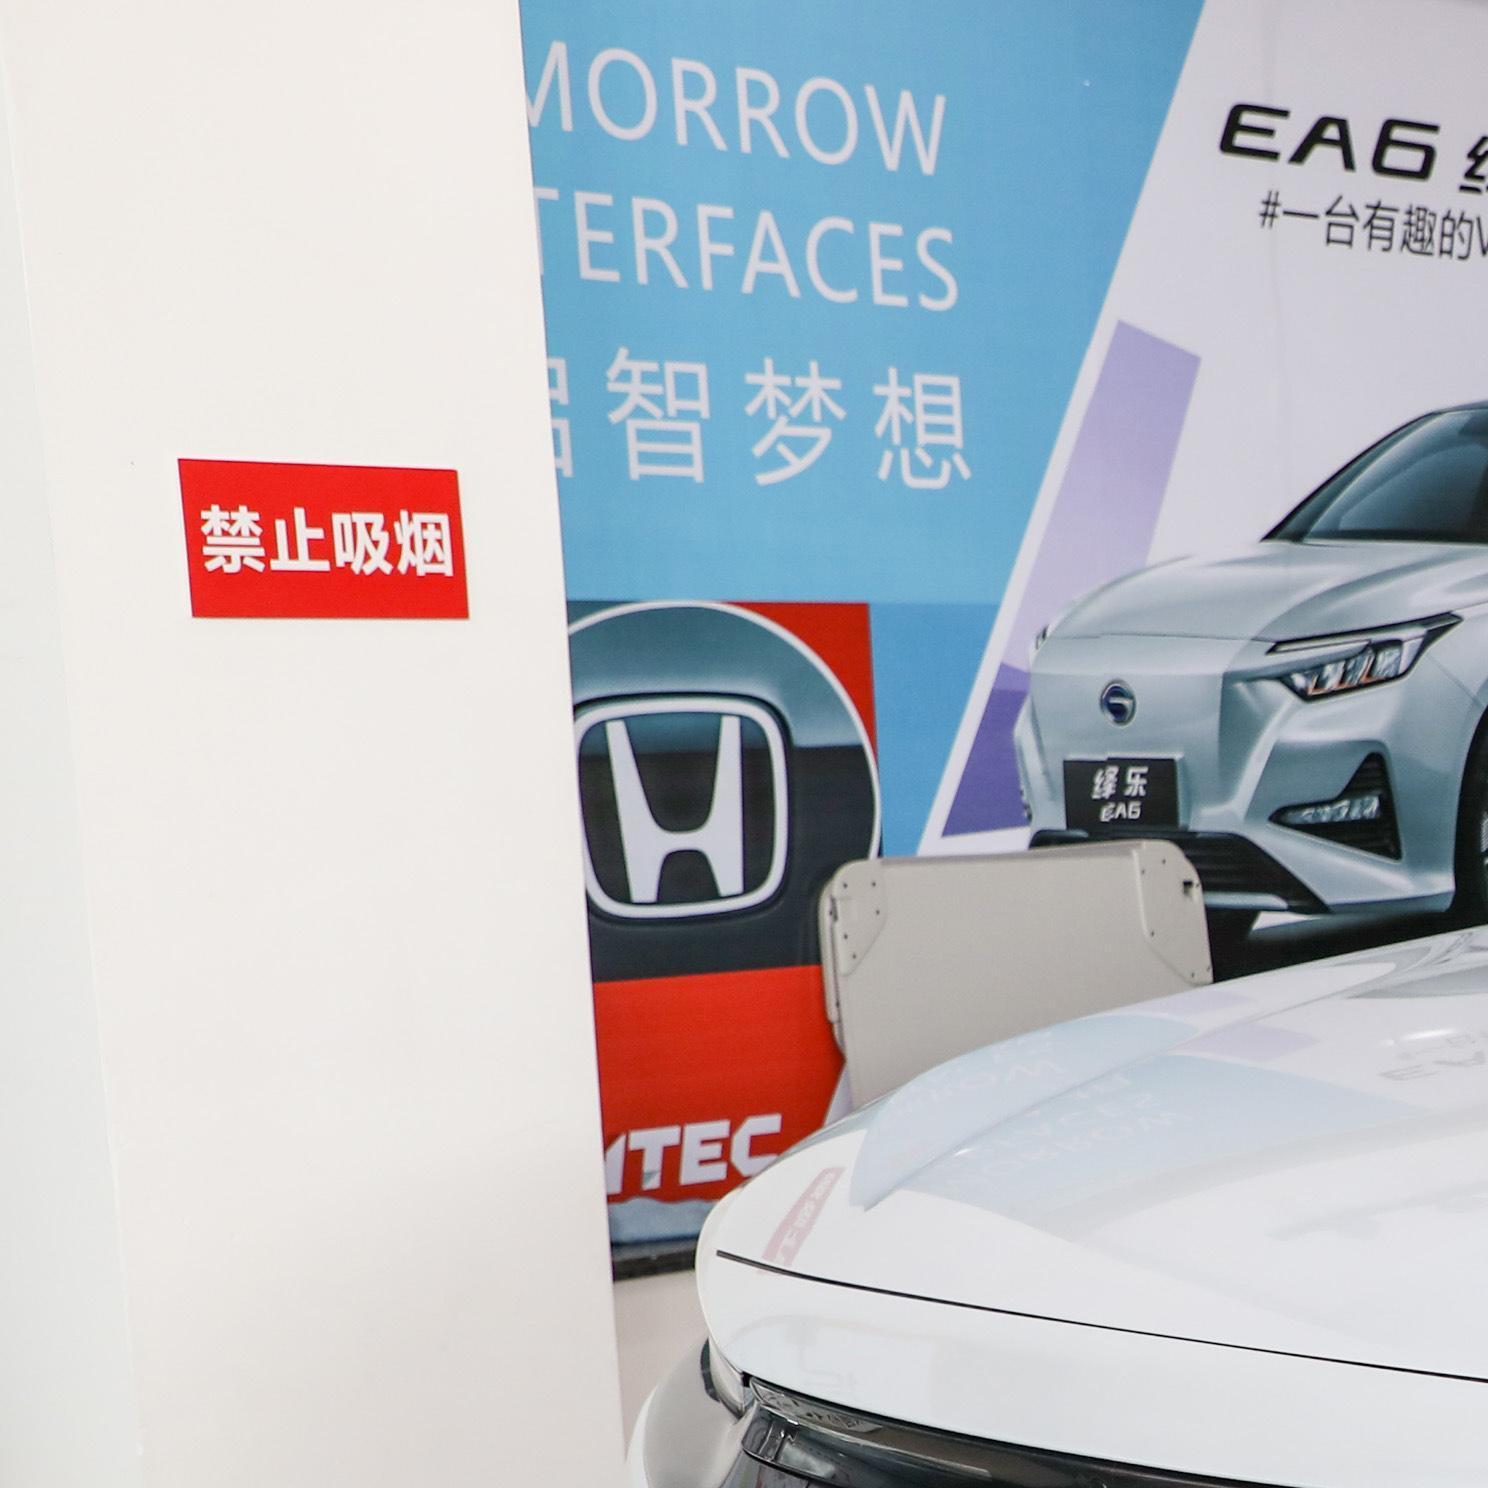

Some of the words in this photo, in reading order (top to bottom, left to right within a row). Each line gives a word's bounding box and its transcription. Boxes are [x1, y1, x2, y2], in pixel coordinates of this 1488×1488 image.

[1219, 103, 1441, 181] EA6
[201, 504, 454, 577] 禁止吸烟
